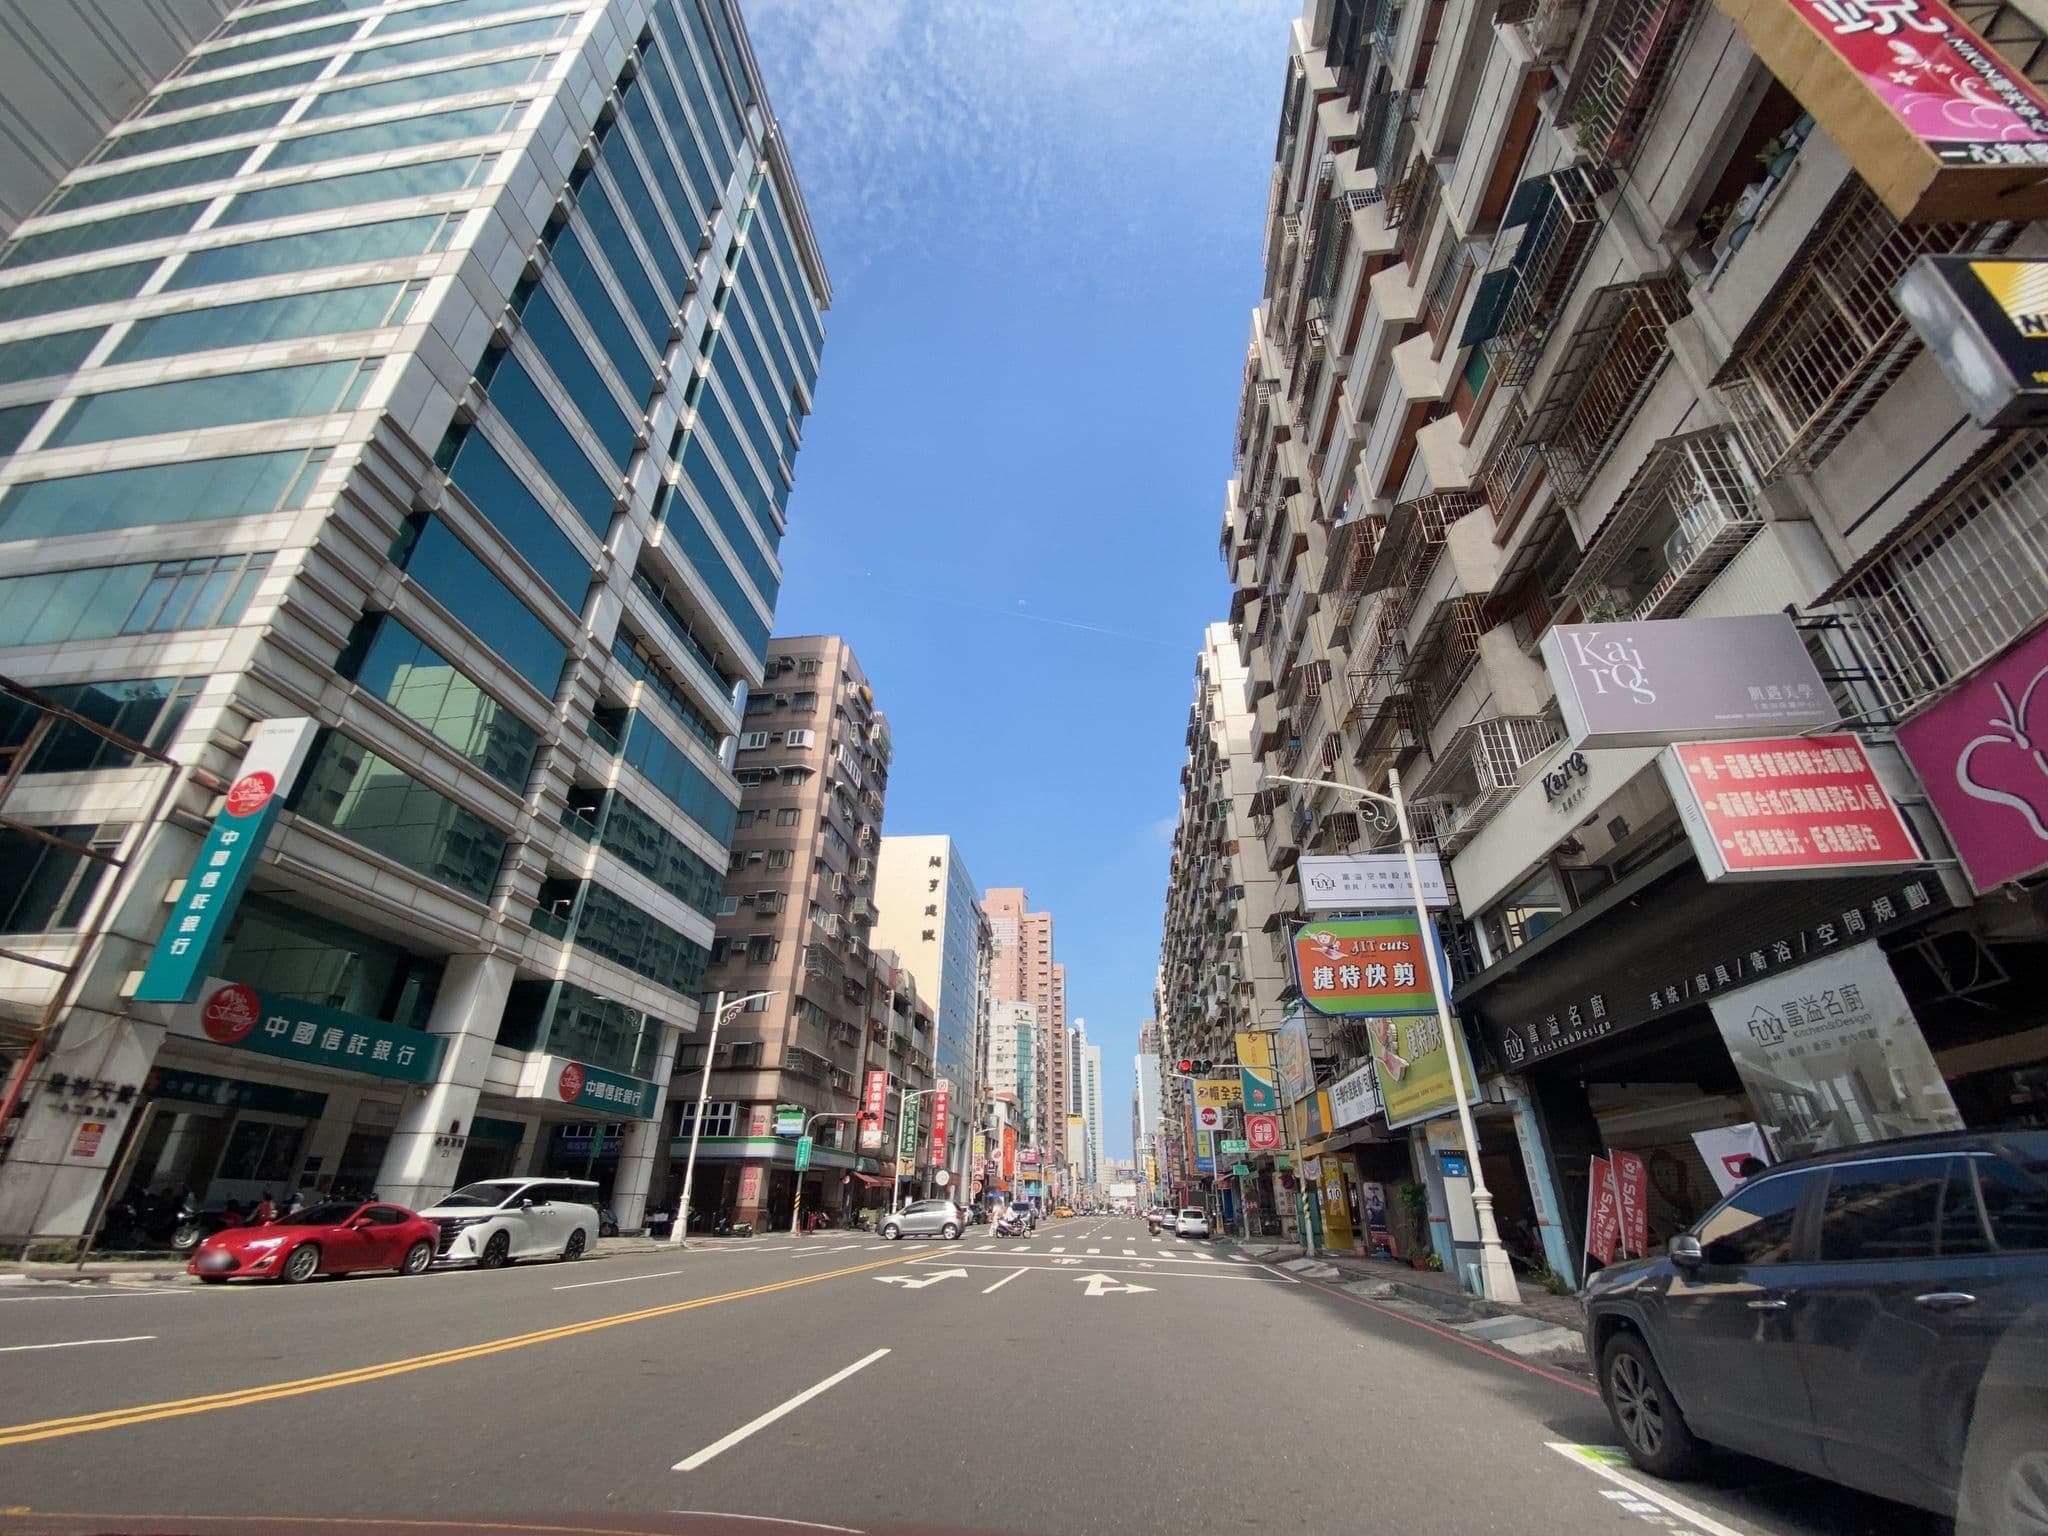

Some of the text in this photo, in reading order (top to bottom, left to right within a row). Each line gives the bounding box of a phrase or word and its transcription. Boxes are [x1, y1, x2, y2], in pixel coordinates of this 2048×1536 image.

[170, 830, 240, 955] 中國信託銀行
[1379, 939, 1410, 951] cuts
[1312, 962, 1415, 991] 捷特快剪
[1526, 994, 1607, 1044] 富溢名廚
[1782, 983, 1866, 1028] 富溢名廚
[264, 1015, 417, 1066] 中國信託銀行
[1533, 1021, 1612, 1057] Kitchen&Design
[1791, 1012, 1873, 1039] Kitchen&Design
[585, 1079, 642, 1107] 中國信託銀行
